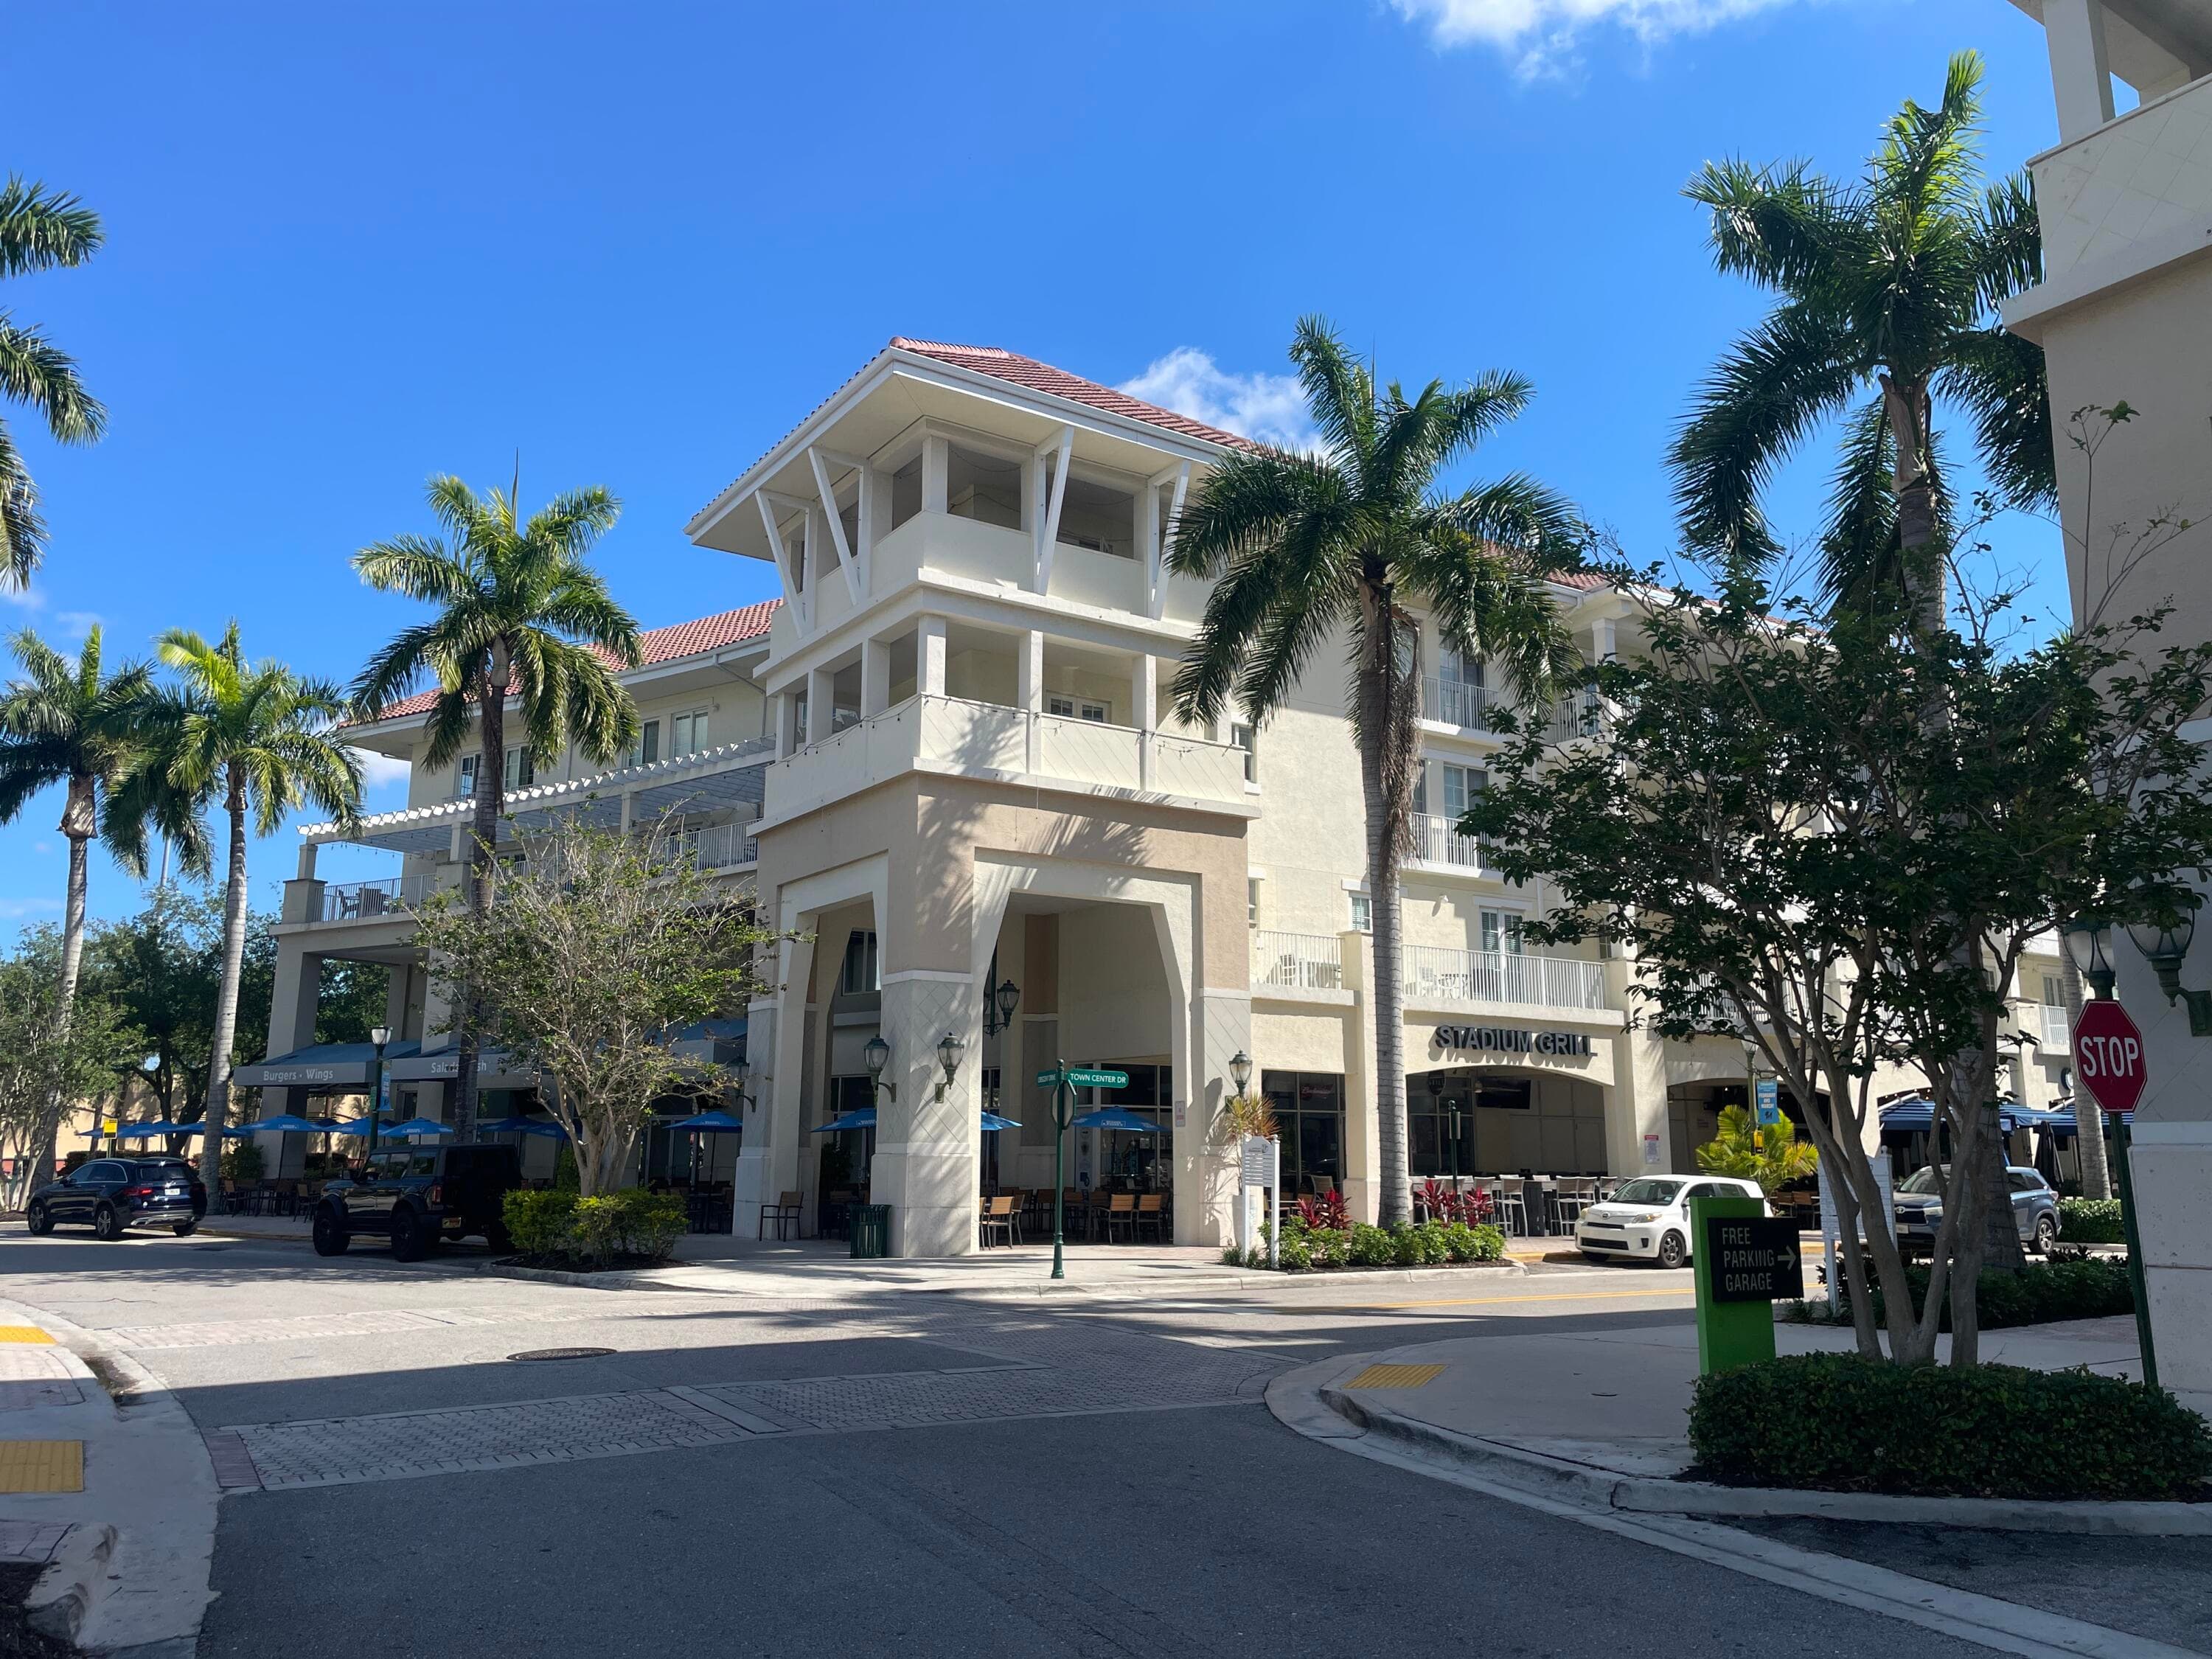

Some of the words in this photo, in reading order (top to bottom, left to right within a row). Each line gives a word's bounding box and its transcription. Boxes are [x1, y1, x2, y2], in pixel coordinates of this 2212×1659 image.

[1435, 1024, 1533, 1053] STADIUM
[1535, 1032, 1598, 1057] GRILL
[2080, 1035, 2139, 1077] STOP
[263, 1070, 296, 1082] Burgers
[306, 1068, 333, 1081] Wings
[1070, 1073, 1091, 1082] TOWN
[1091, 1074, 1116, 1083] CENTER
[1117, 1076, 1126, 1084] DR
[1722, 1227, 1751, 1245] FREE
[1723, 1249, 1775, 1267] PARKING
[1725, 1273, 1773, 1292] GARAGE
